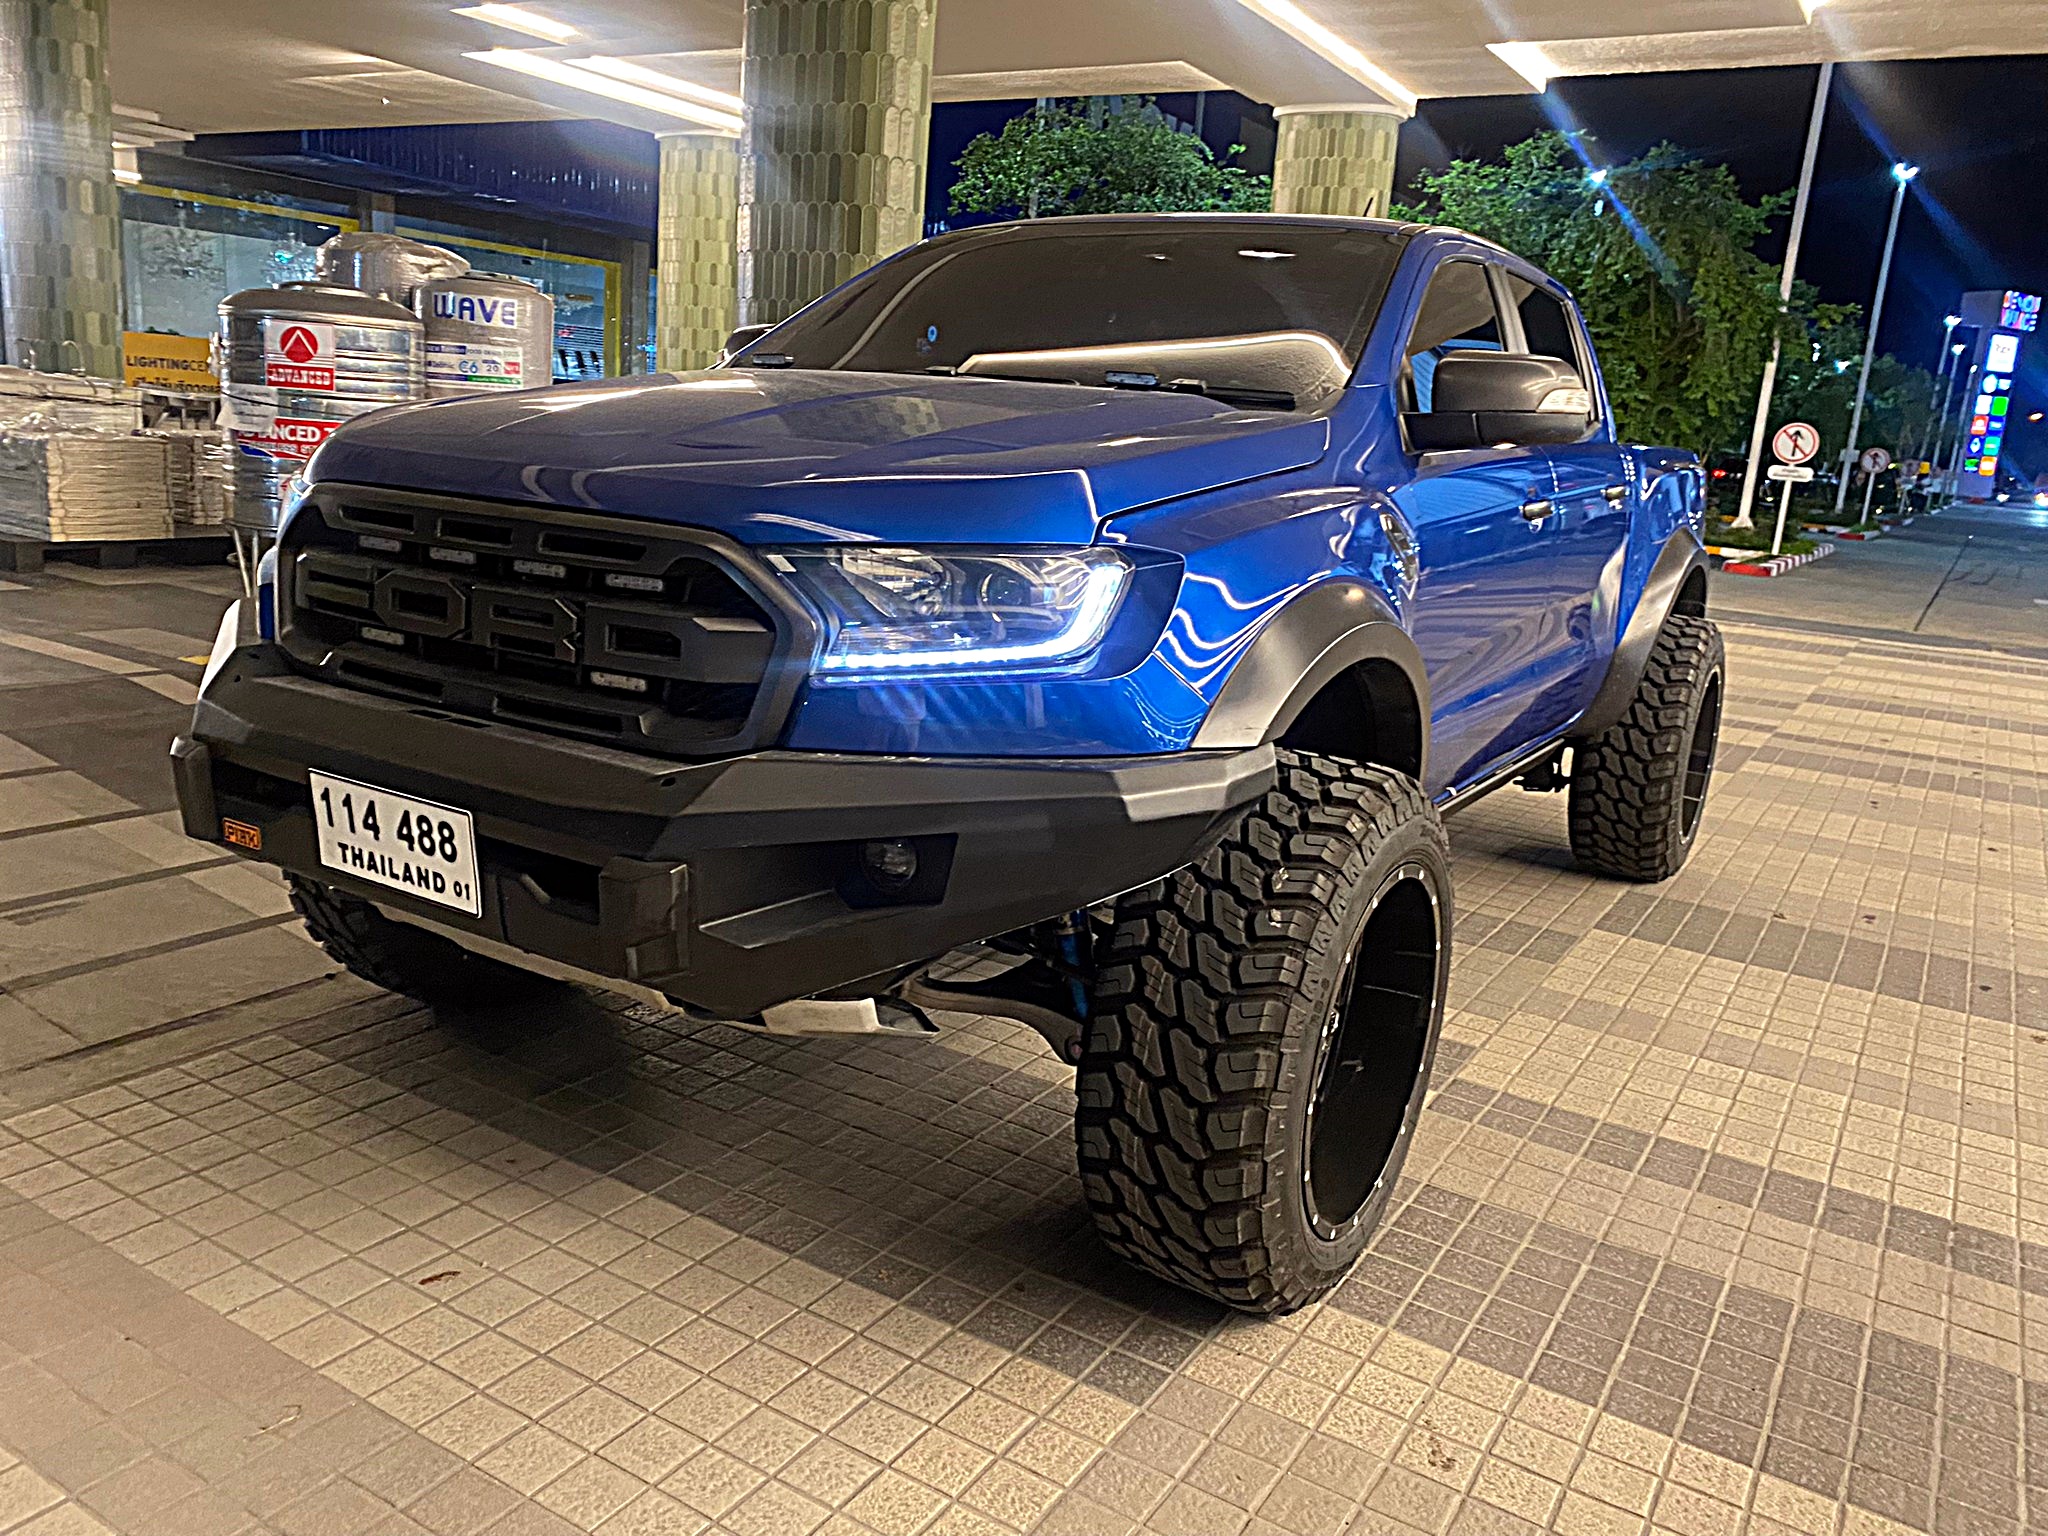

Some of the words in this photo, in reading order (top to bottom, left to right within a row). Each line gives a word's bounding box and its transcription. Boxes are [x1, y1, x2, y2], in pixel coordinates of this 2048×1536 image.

[434, 294, 515, 326] WAVE
[320, 787, 380, 841] 114
[397, 809, 458, 863] 488
[337, 841, 446, 894] THAILAND
[454, 880, 470, 900] 01
